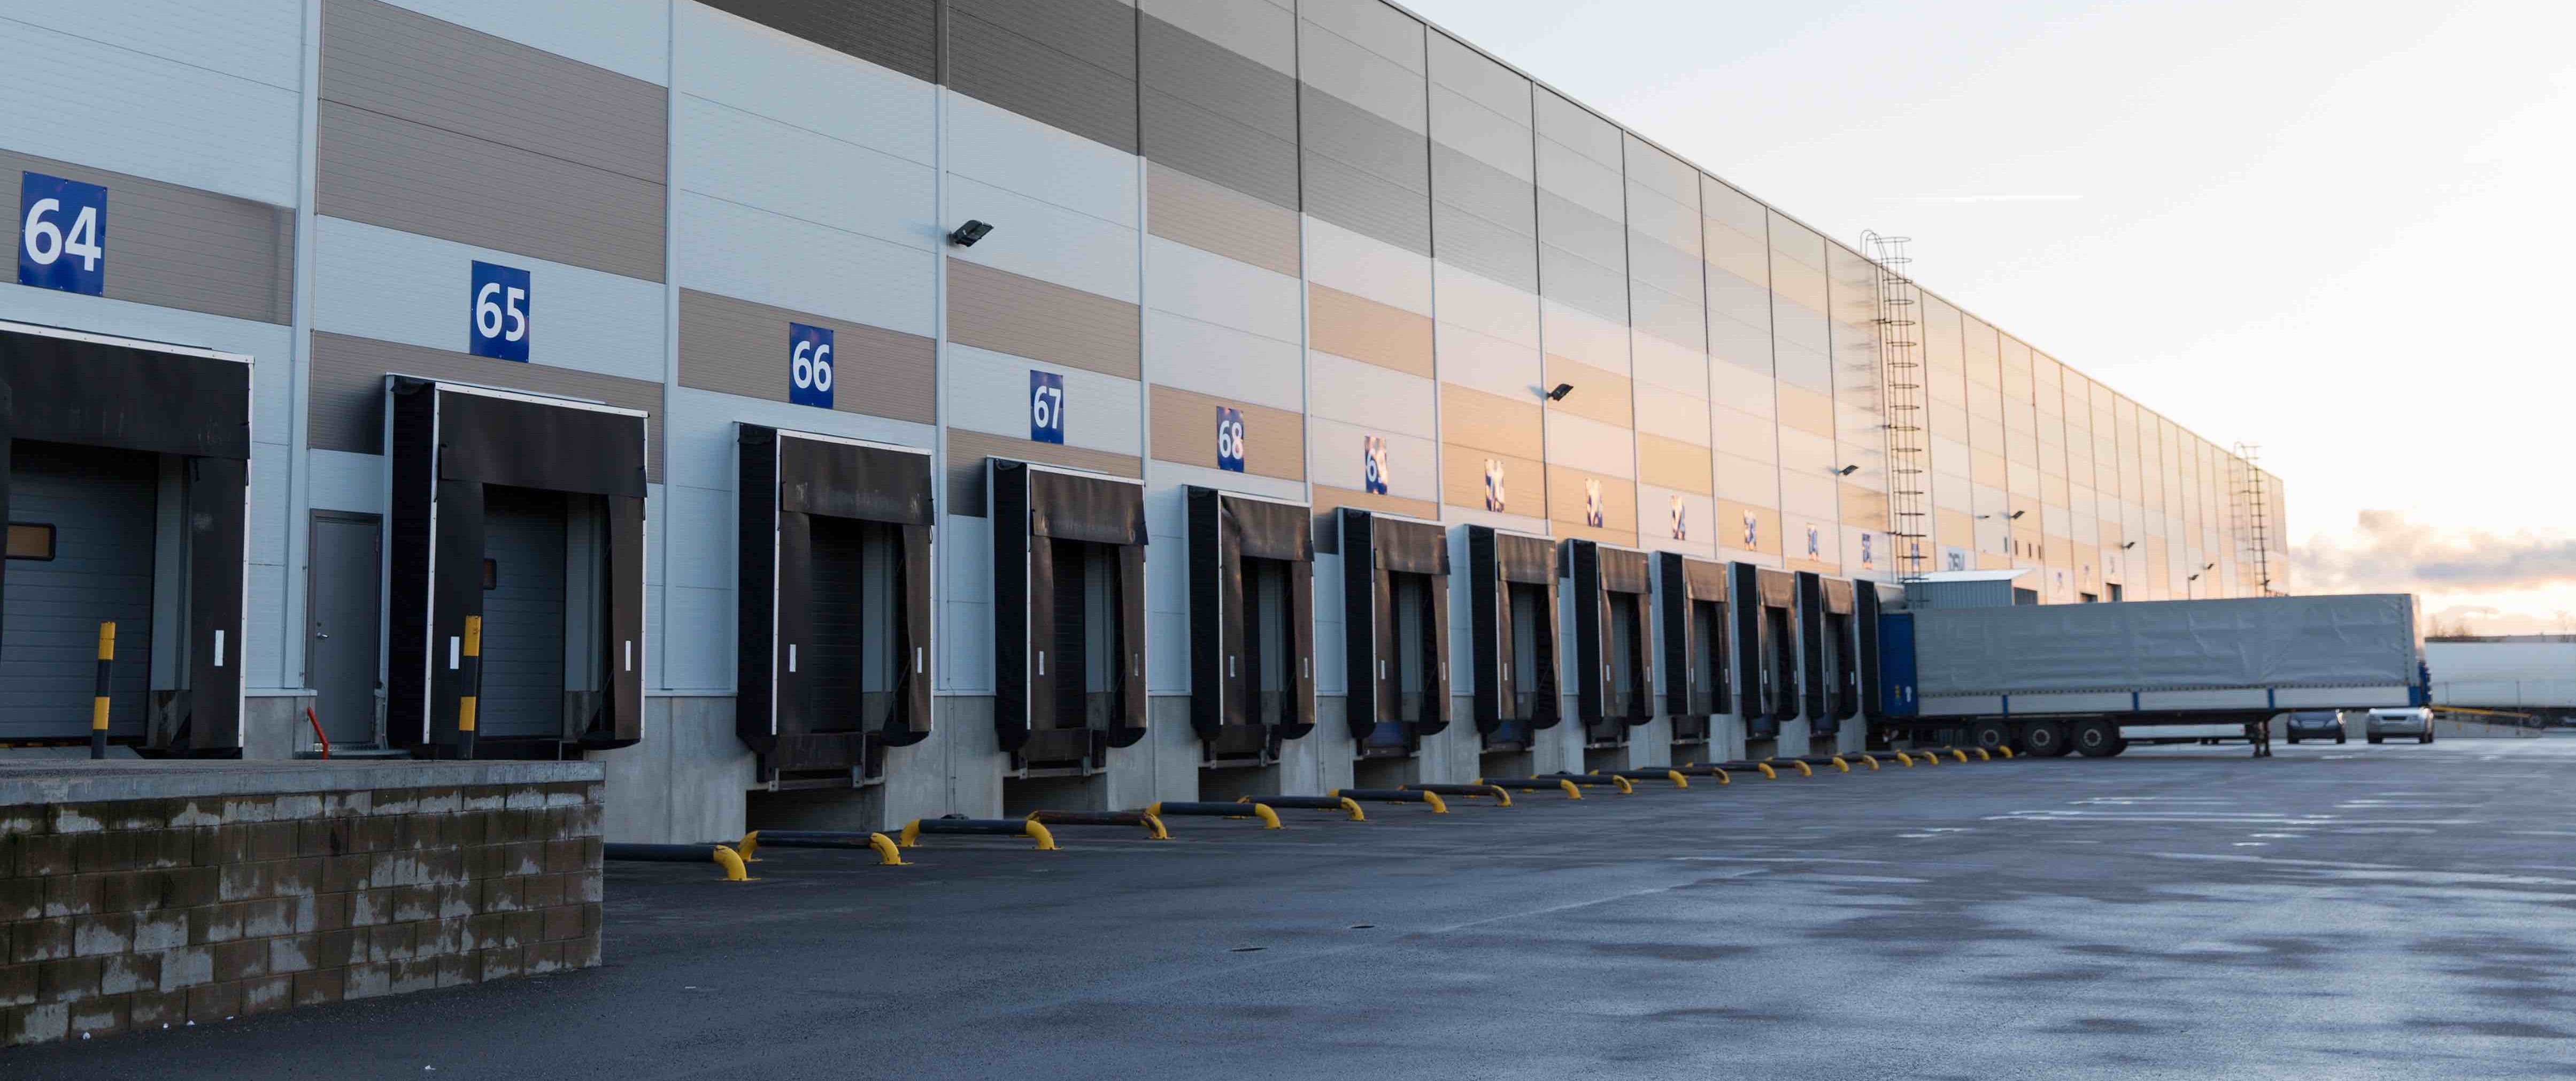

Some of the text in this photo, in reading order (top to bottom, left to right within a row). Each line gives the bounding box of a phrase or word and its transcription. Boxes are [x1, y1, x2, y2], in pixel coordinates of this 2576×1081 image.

[25, 198, 102, 271] 64
[476, 282, 526, 341] 65
[793, 341, 831, 392] 66
[1034, 385, 1061, 429] 67
[1219, 420, 1244, 459] 68
